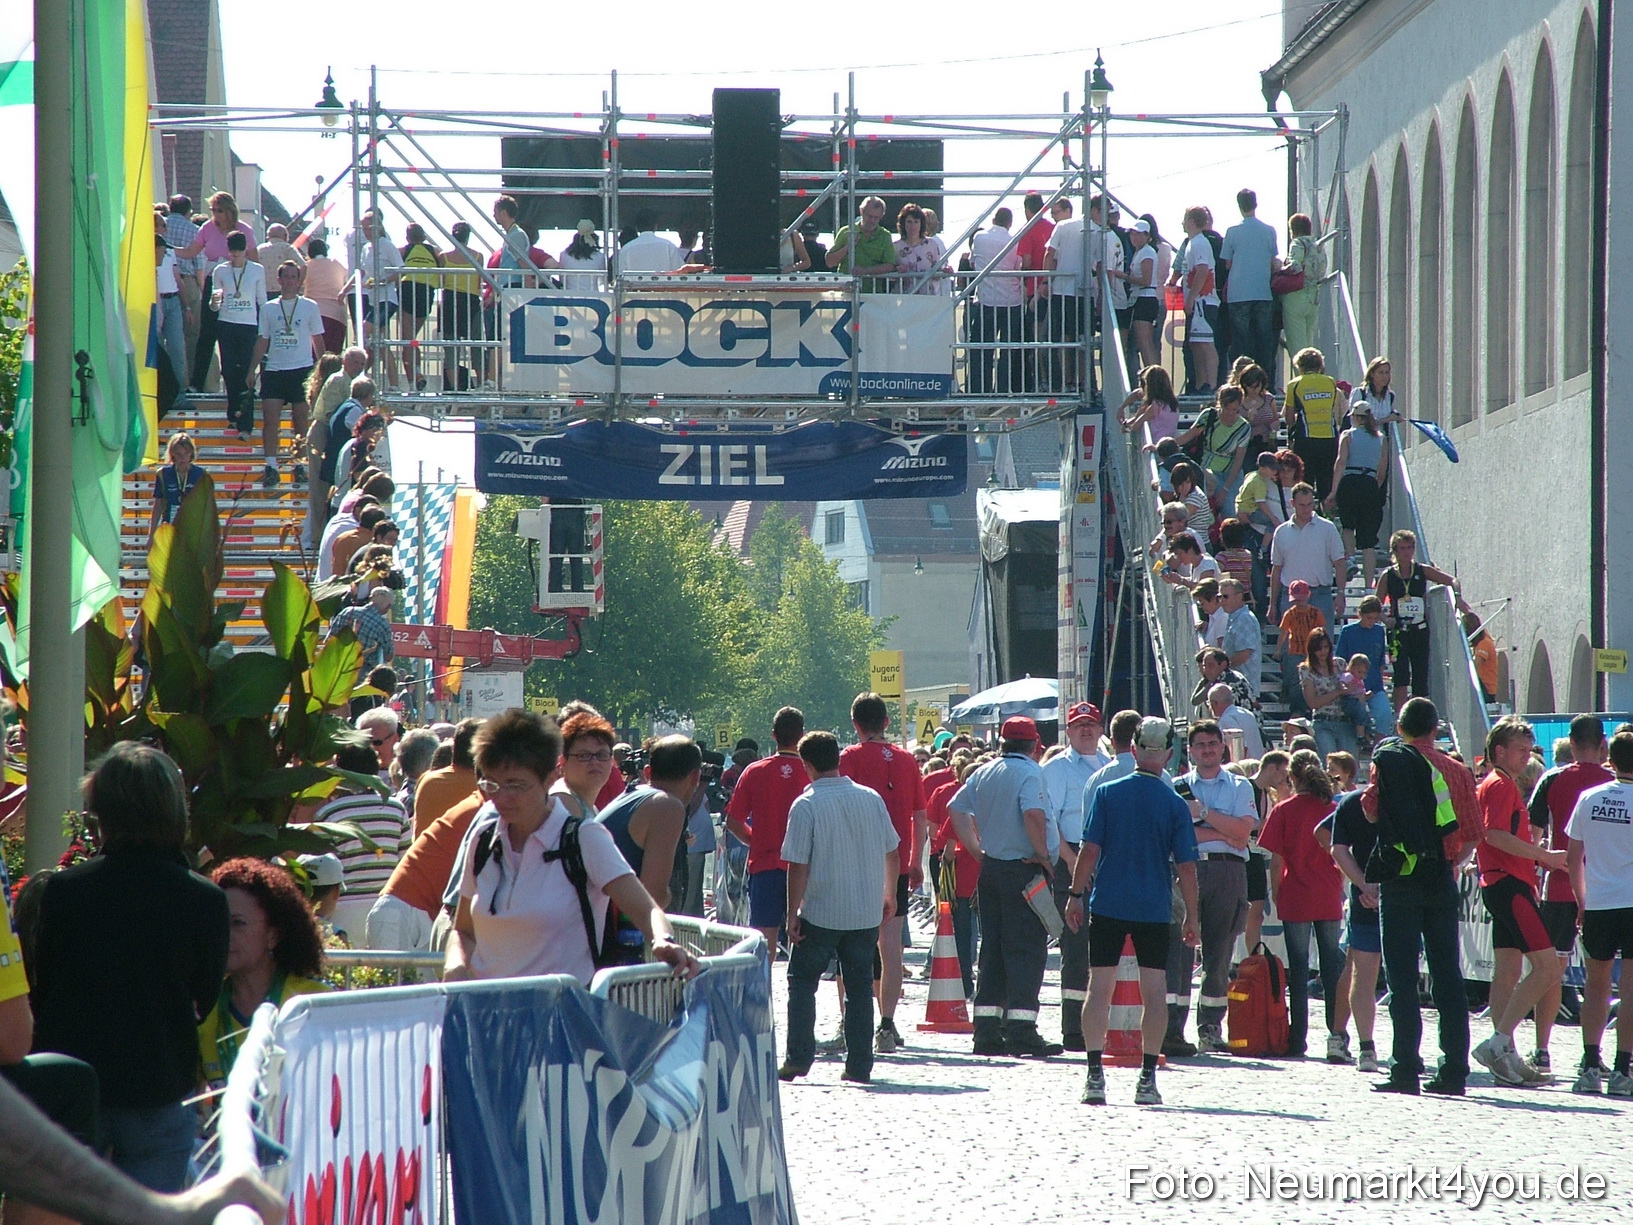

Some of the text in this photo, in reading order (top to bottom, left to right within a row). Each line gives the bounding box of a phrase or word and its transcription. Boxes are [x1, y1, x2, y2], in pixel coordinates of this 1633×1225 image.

[510, 297, 861, 367] BOCK
[658, 444, 785, 485] ZIEL
[871, 665, 900, 674] Jugend
[881, 674, 895, 682] lauf
[535, 699, 555, 707] Block
[919, 709, 939, 717] Block
[922, 720, 936, 738] A
[720, 731, 728, 743] B
[1602, 797, 1625, 807] Team
[1591, 805, 1631, 819] PARTL
